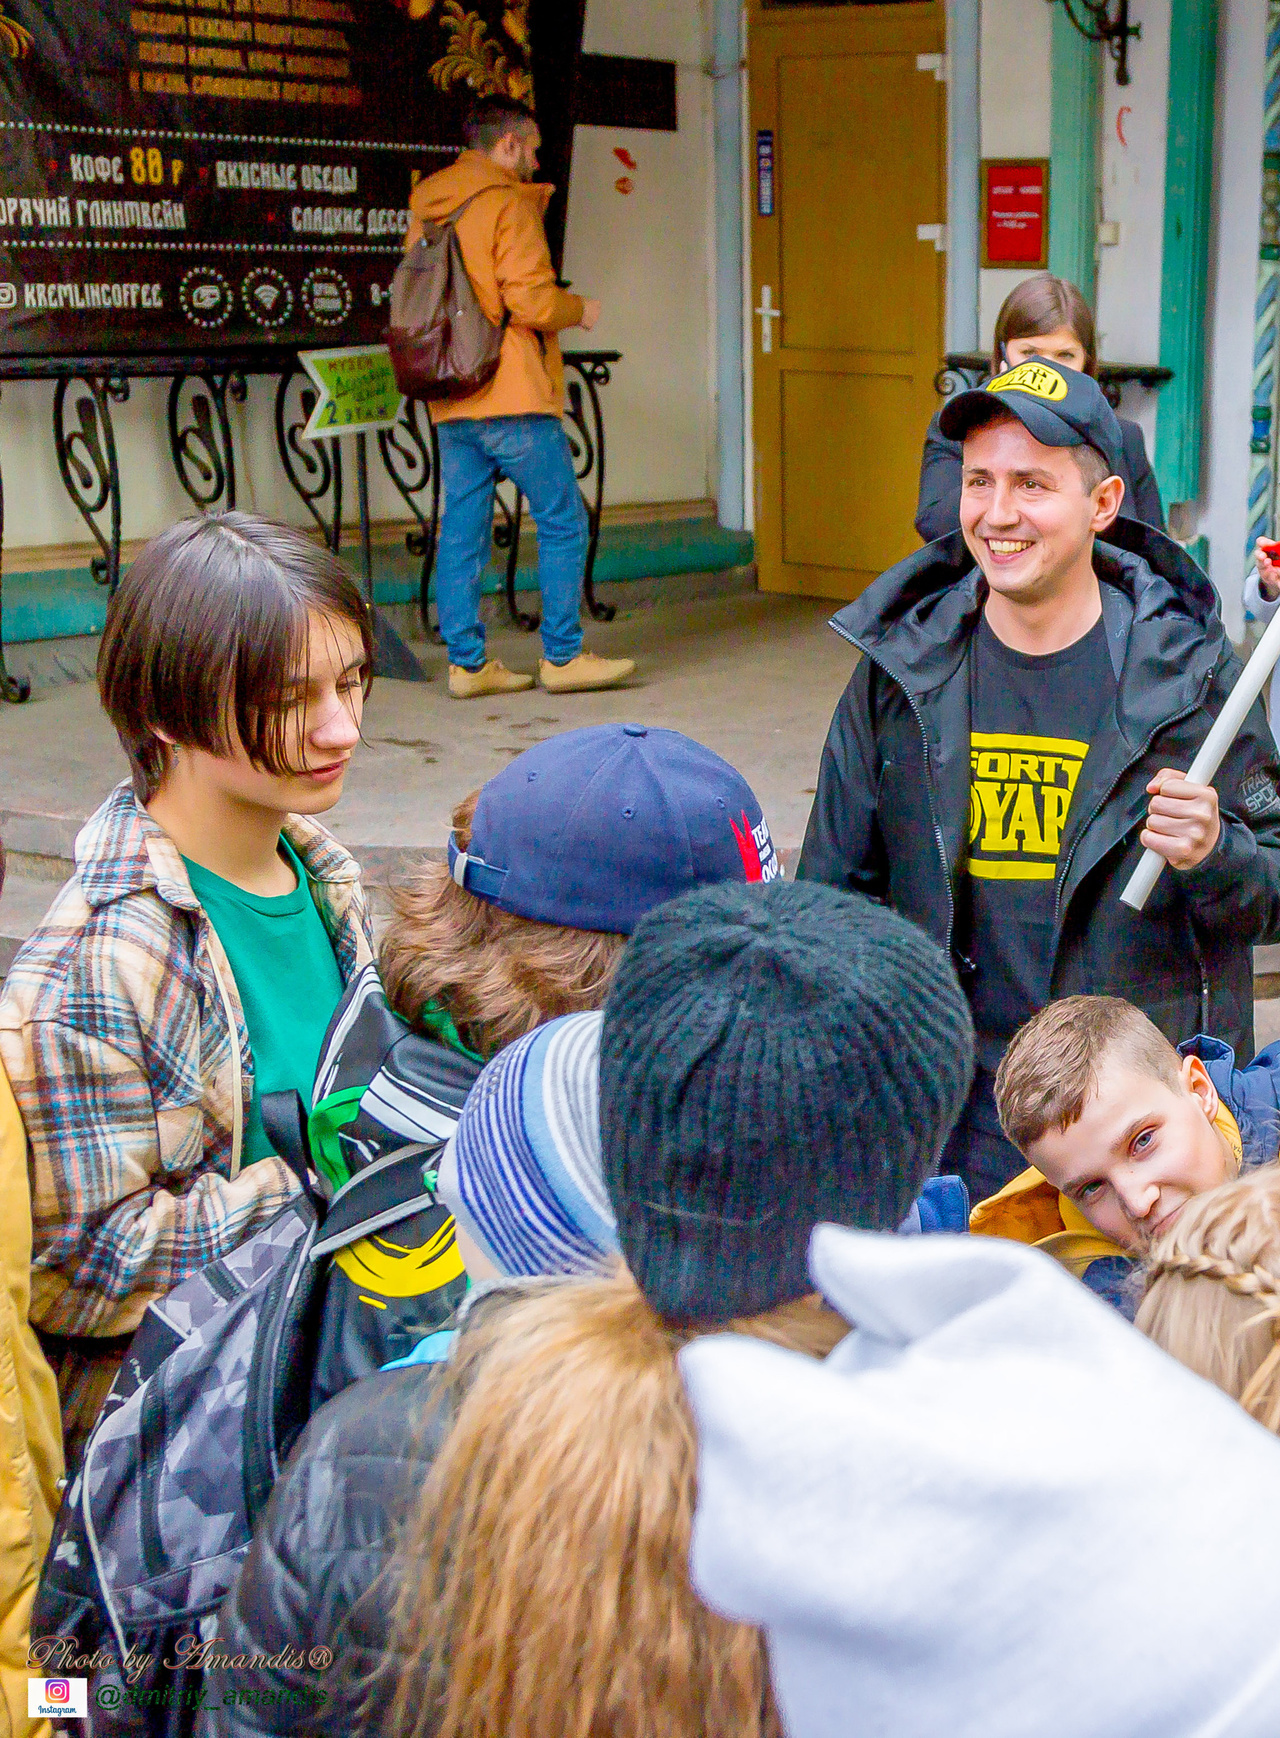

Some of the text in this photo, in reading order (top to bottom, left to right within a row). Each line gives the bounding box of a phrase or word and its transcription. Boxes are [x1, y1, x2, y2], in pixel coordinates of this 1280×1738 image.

[70, 153, 124, 184] КОФЕ
[130, 146, 164, 186] 80
[215, 160, 358, 195] ВКУСНЫЕ ОБЕДЫ
[76, 199, 187, 230] ГЛИНТВЕЙН
[291, 206, 364, 236] СЛАДКИЕ
[24, 282, 163, 309] KREMLINCOFFEE
